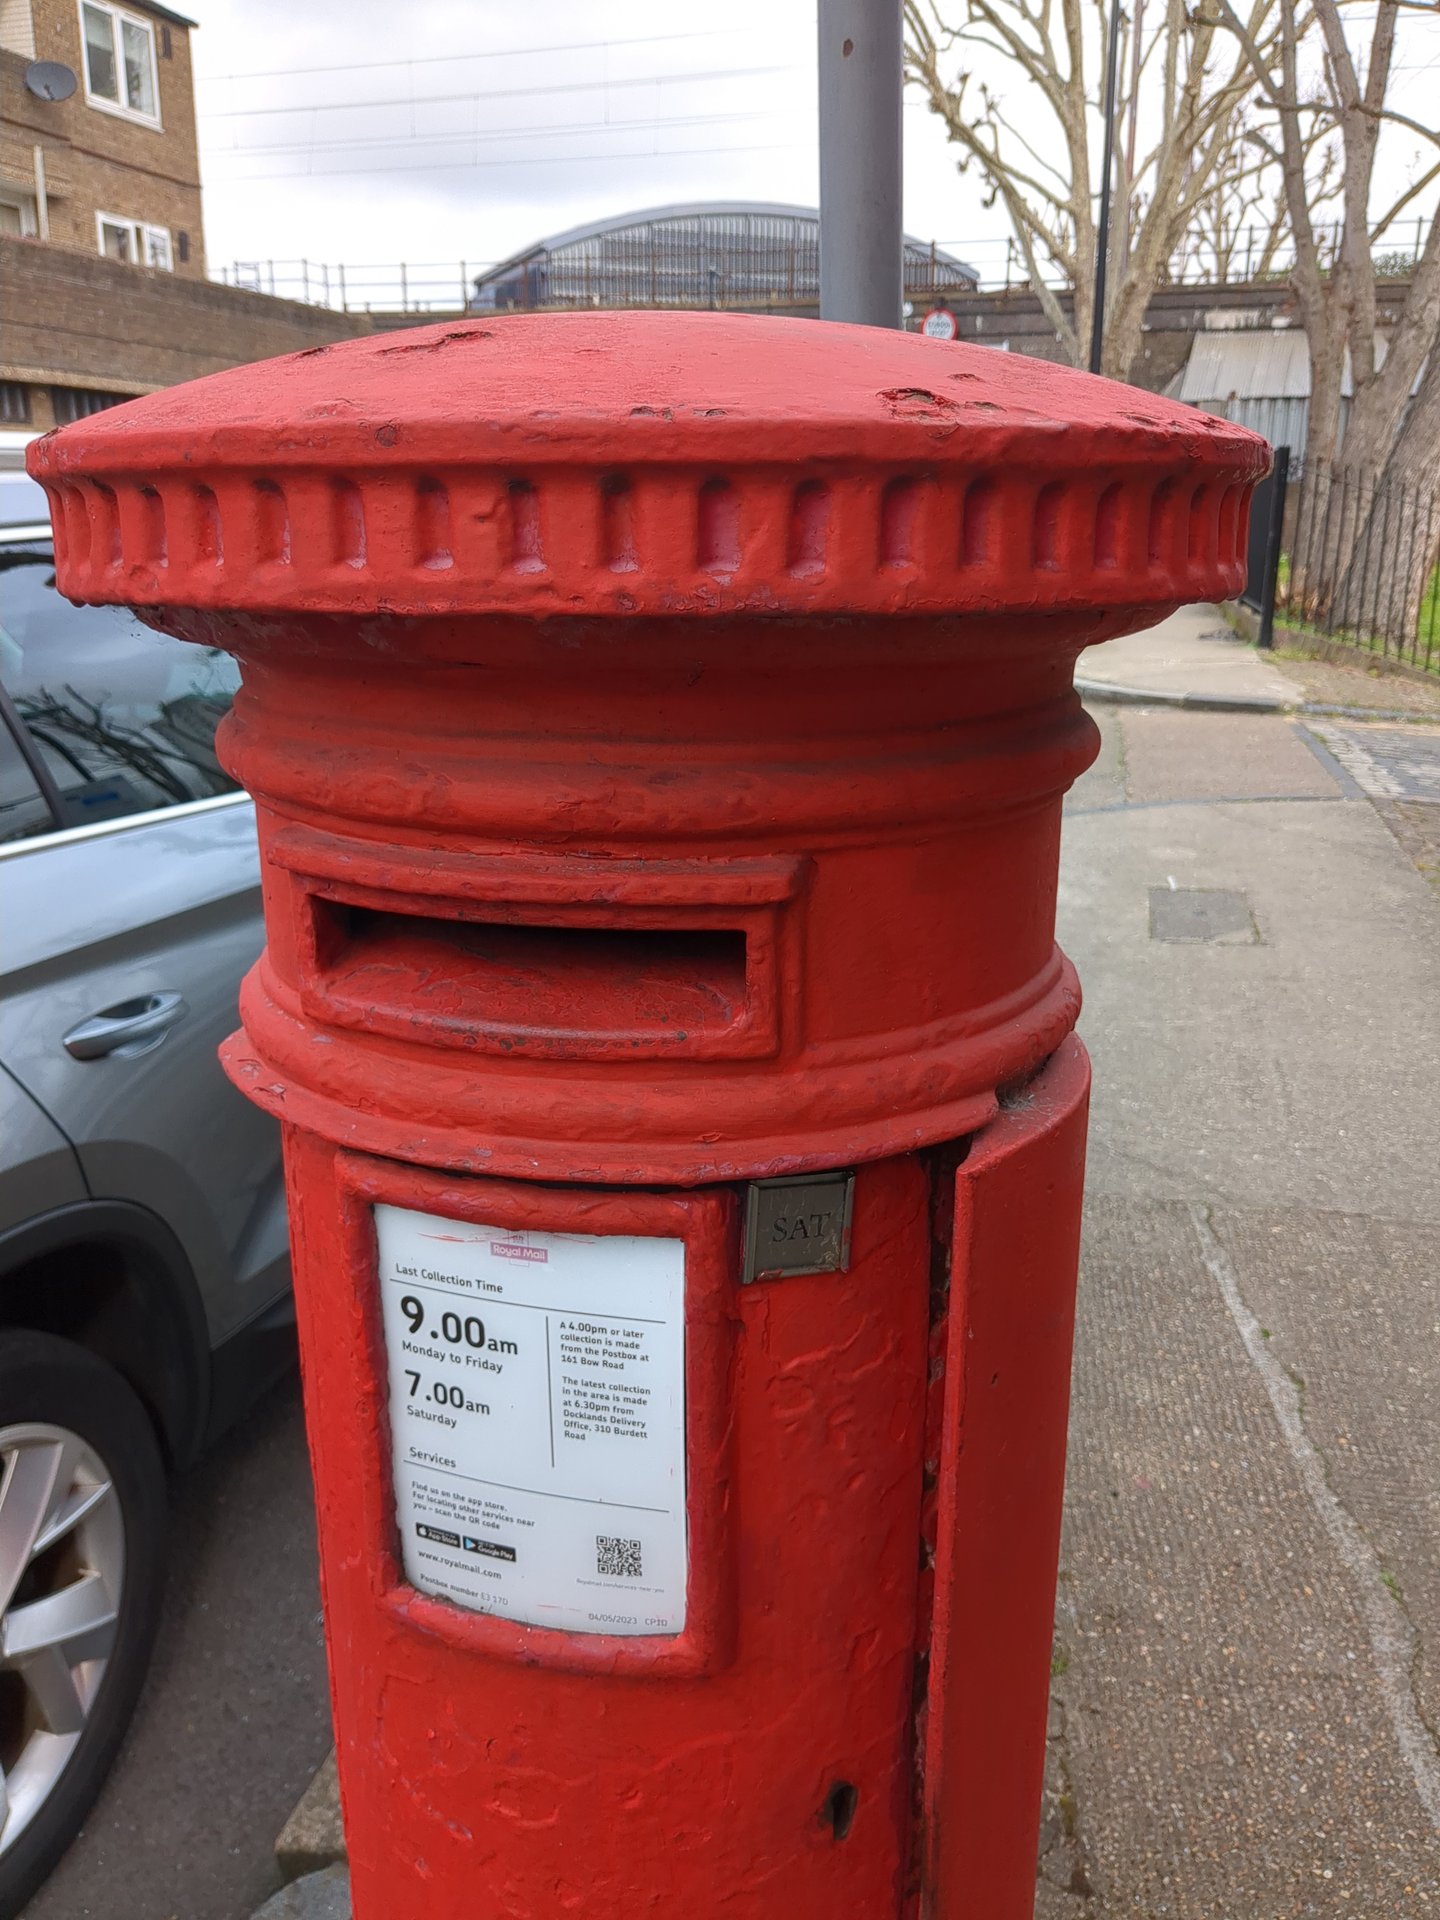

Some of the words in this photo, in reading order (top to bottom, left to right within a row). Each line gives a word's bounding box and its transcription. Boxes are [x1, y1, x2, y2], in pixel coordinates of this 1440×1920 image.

[772, 1212, 830, 1242] SAT
[493, 1244, 520, 1256] Royal
[524, 1248, 545, 1258] Mail
[395, 1263, 418, 1276] Last
[421, 1269, 472, 1288] Collection
[475, 1280, 503, 1293] Time
[400, 1296, 518, 1355] 9.00am
[560, 1321, 566, 1329] A
[568, 1321, 607, 1334] 4.00pm
[623, 1329, 644, 1338] later
[560, 1334, 602, 1345] collection
[605, 1338, 612, 1346] is
[616, 1340, 640, 1350] made
[560, 1344, 582, 1353] from
[584, 1347, 599, 1356] the
[602, 1348, 637, 1360] Postbox
[402, 1340, 446, 1362] Monday
[450, 1352, 461, 1364] to
[466, 1356, 503, 1374] Friday
[561, 1354, 578, 1364] 161
[581, 1357, 599, 1366] Bow
[602, 1360, 624, 1370] Road
[404, 1369, 490, 1415] 7.00am
[562, 1376, 578, 1386] The
[581, 1379, 606, 1389] latest
[608, 1384, 651, 1395] collection
[562, 1386, 570, 1394] in
[574, 1389, 588, 1397] the
[612, 1394, 620, 1402] is
[623, 1396, 648, 1406] made
[407, 1405, 458, 1429] Saturday
[574, 1400, 610, 1412] 6.30pm
[612, 1405, 634, 1415] from
[564, 1409, 607, 1422] Docklands
[610, 1416, 646, 1428] Delivery
[564, 1420, 592, 1432] Office,
[594, 1424, 611, 1433] 310
[614, 1426, 648, 1438] Burdett
[564, 1430, 586, 1440] Road
[410, 1446, 456, 1468] Services
[412, 1480, 428, 1492] Find
[442, 1490, 451, 1498] on
[452, 1492, 466, 1502] the
[468, 1497, 482, 1506] app
[412, 1491, 424, 1500] For
[426, 1494, 456, 1510] locating
[458, 1504, 480, 1514] other
[482, 1510, 514, 1522] services
[516, 1518, 536, 1527] near
[413, 1502, 426, 1510] you
[434, 1509, 452, 1517] scan
[454, 1512, 466, 1522] the
[468, 1515, 480, 1524] QR
[482, 1520, 500, 1530] code
[418, 1550, 502, 1580] www.royalmail.com
[420, 1573, 448, 1588] Postbox
[450, 1584, 478, 1597] number
[588, 1613, 638, 1624] 04/05/2023
